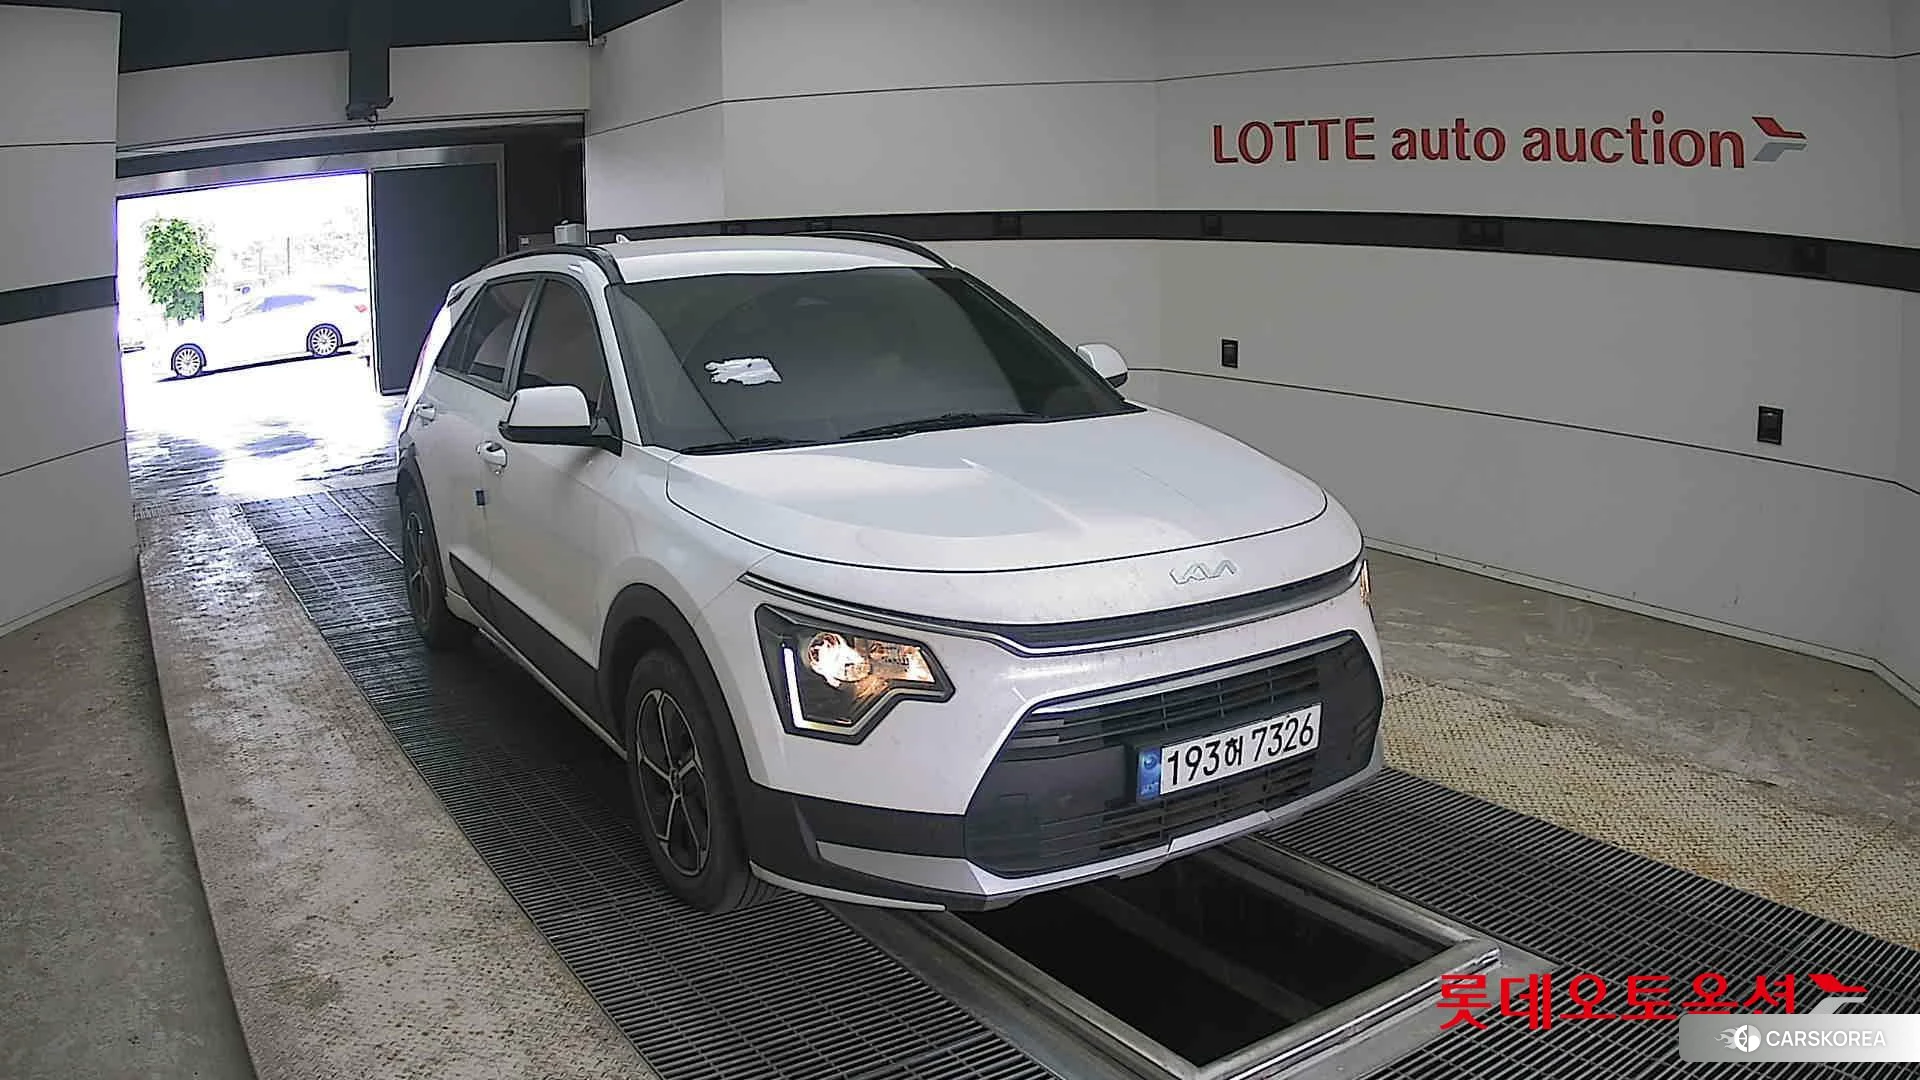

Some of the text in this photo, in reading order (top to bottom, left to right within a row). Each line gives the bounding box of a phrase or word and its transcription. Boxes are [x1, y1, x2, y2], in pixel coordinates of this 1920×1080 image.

[1212, 110, 1746, 169] LOTTE auto auction
[1167, 713, 1314, 785] 193허 7326
